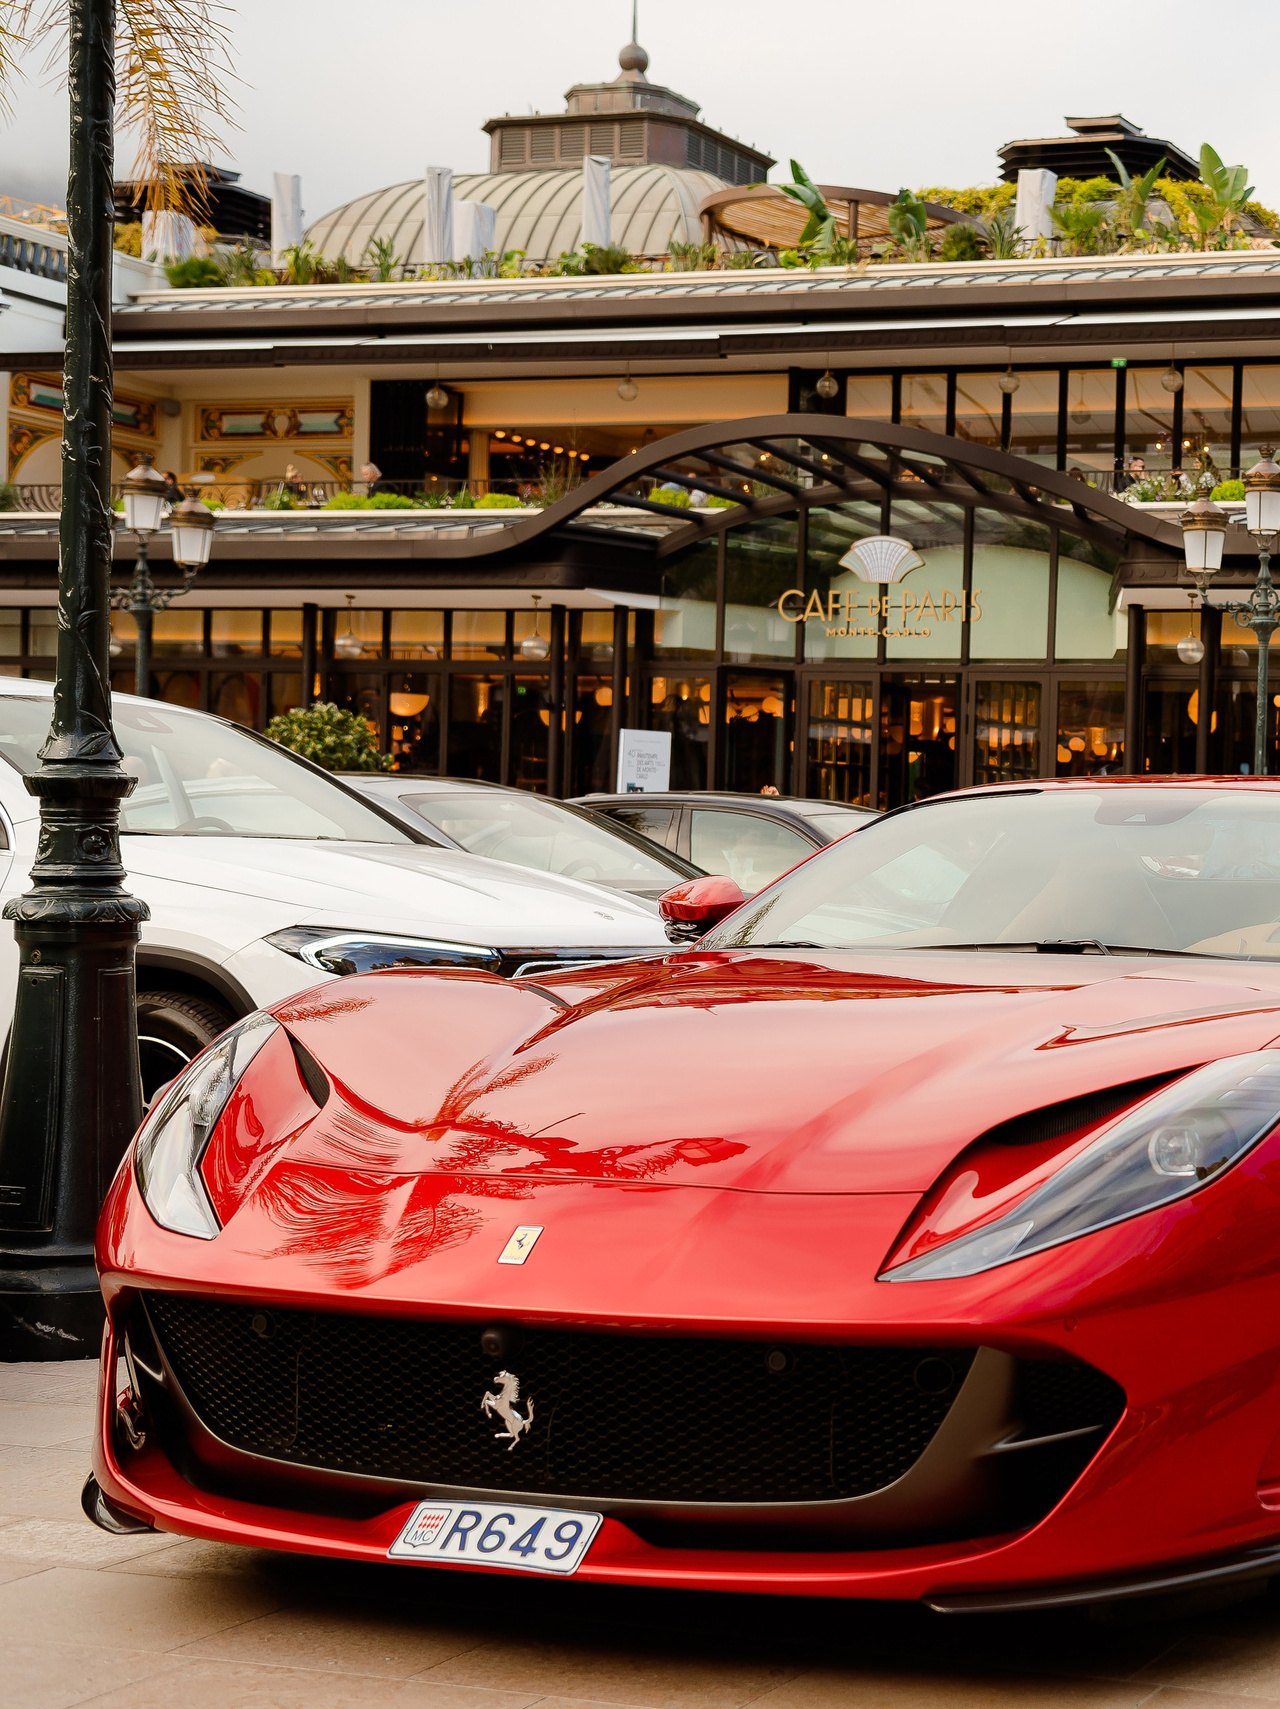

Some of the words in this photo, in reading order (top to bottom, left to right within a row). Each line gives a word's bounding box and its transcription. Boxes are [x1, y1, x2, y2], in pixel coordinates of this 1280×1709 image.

[778, 589, 860, 622] CAFE
[868, 596, 891, 617] DE
[901, 589, 982, 622] PARIS
[826, 627, 931, 638] MONTE-CARLO
[411, 1529, 434, 1541] MC
[440, 1510, 583, 1560] R649
